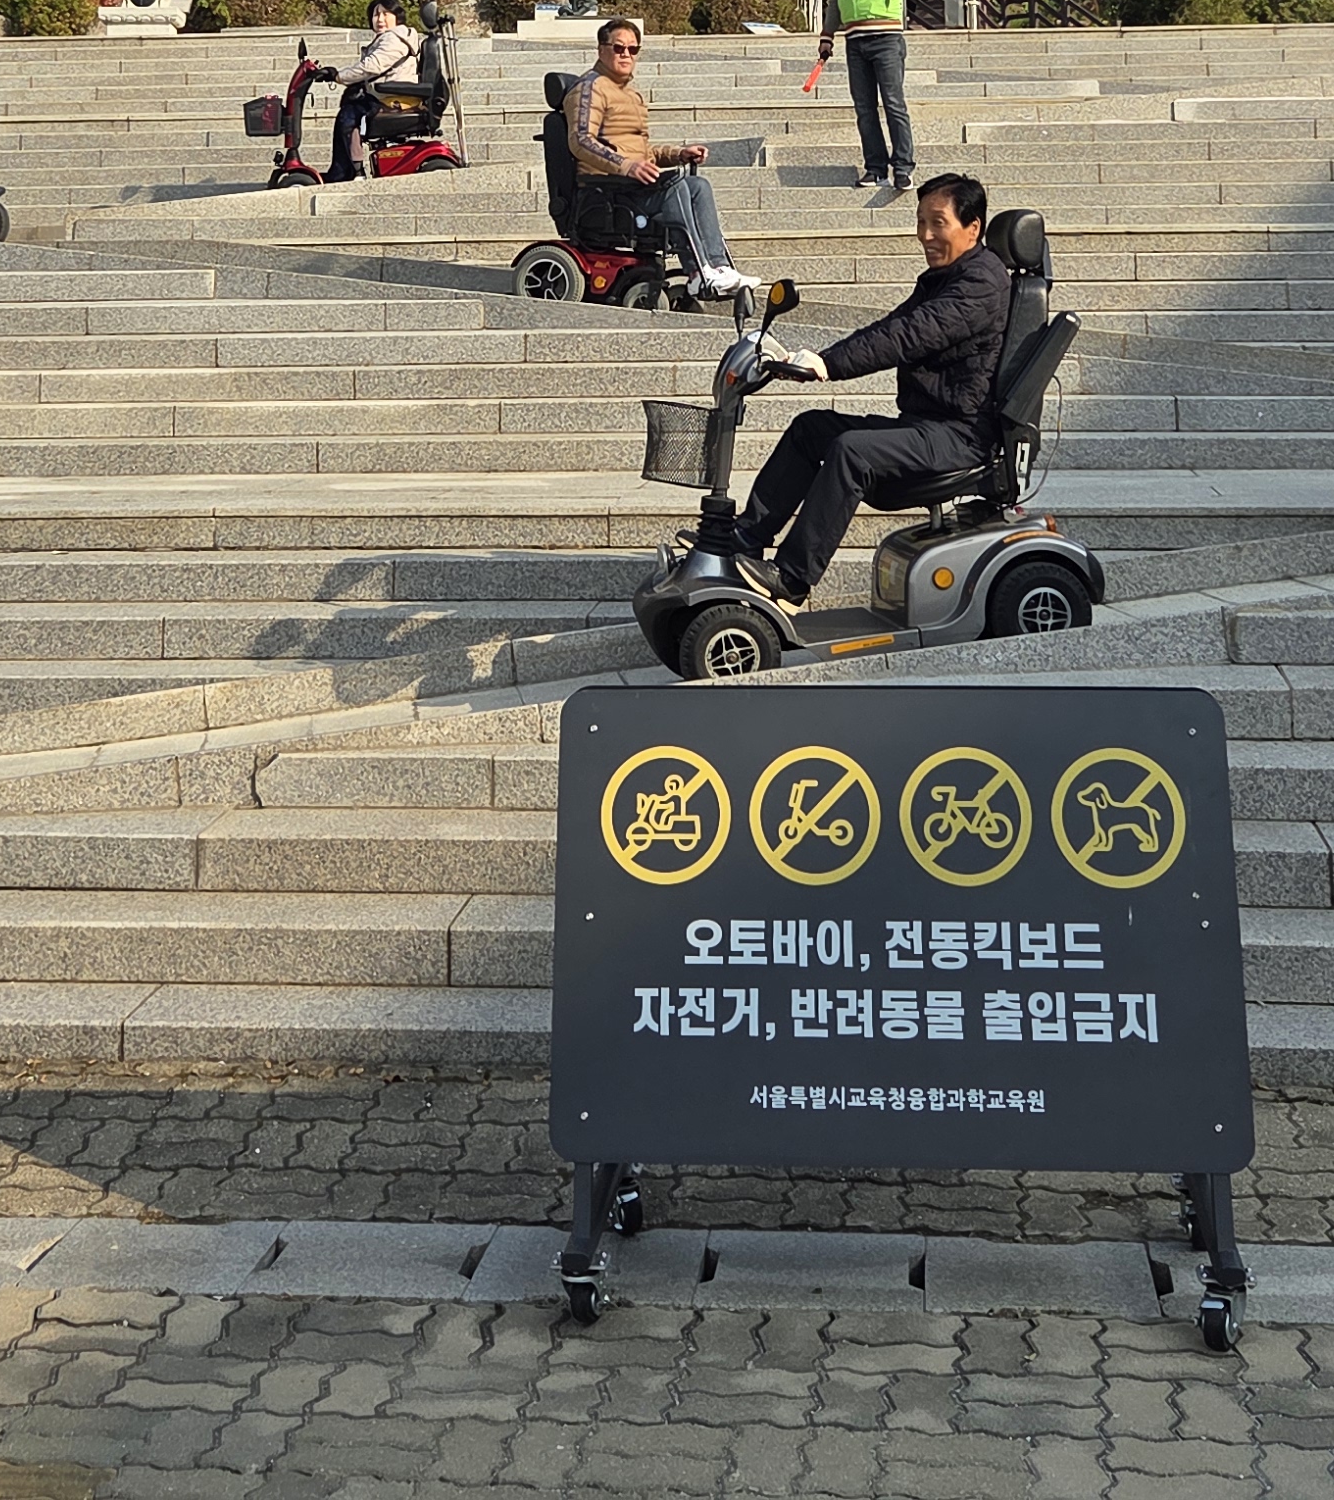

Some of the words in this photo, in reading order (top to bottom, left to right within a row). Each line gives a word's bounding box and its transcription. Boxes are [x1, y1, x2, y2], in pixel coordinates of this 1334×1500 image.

[683, 918, 871, 973] 오토바이,
[884, 919, 1105, 971] 전동킥보드
[632, 986, 777, 1042] 자전거,
[791, 987, 966, 1041] 반려동물
[981, 989, 1160, 1044] 출입금지
[749, 1084, 1046, 1113] 서울특별시교육청융합과학교육원
